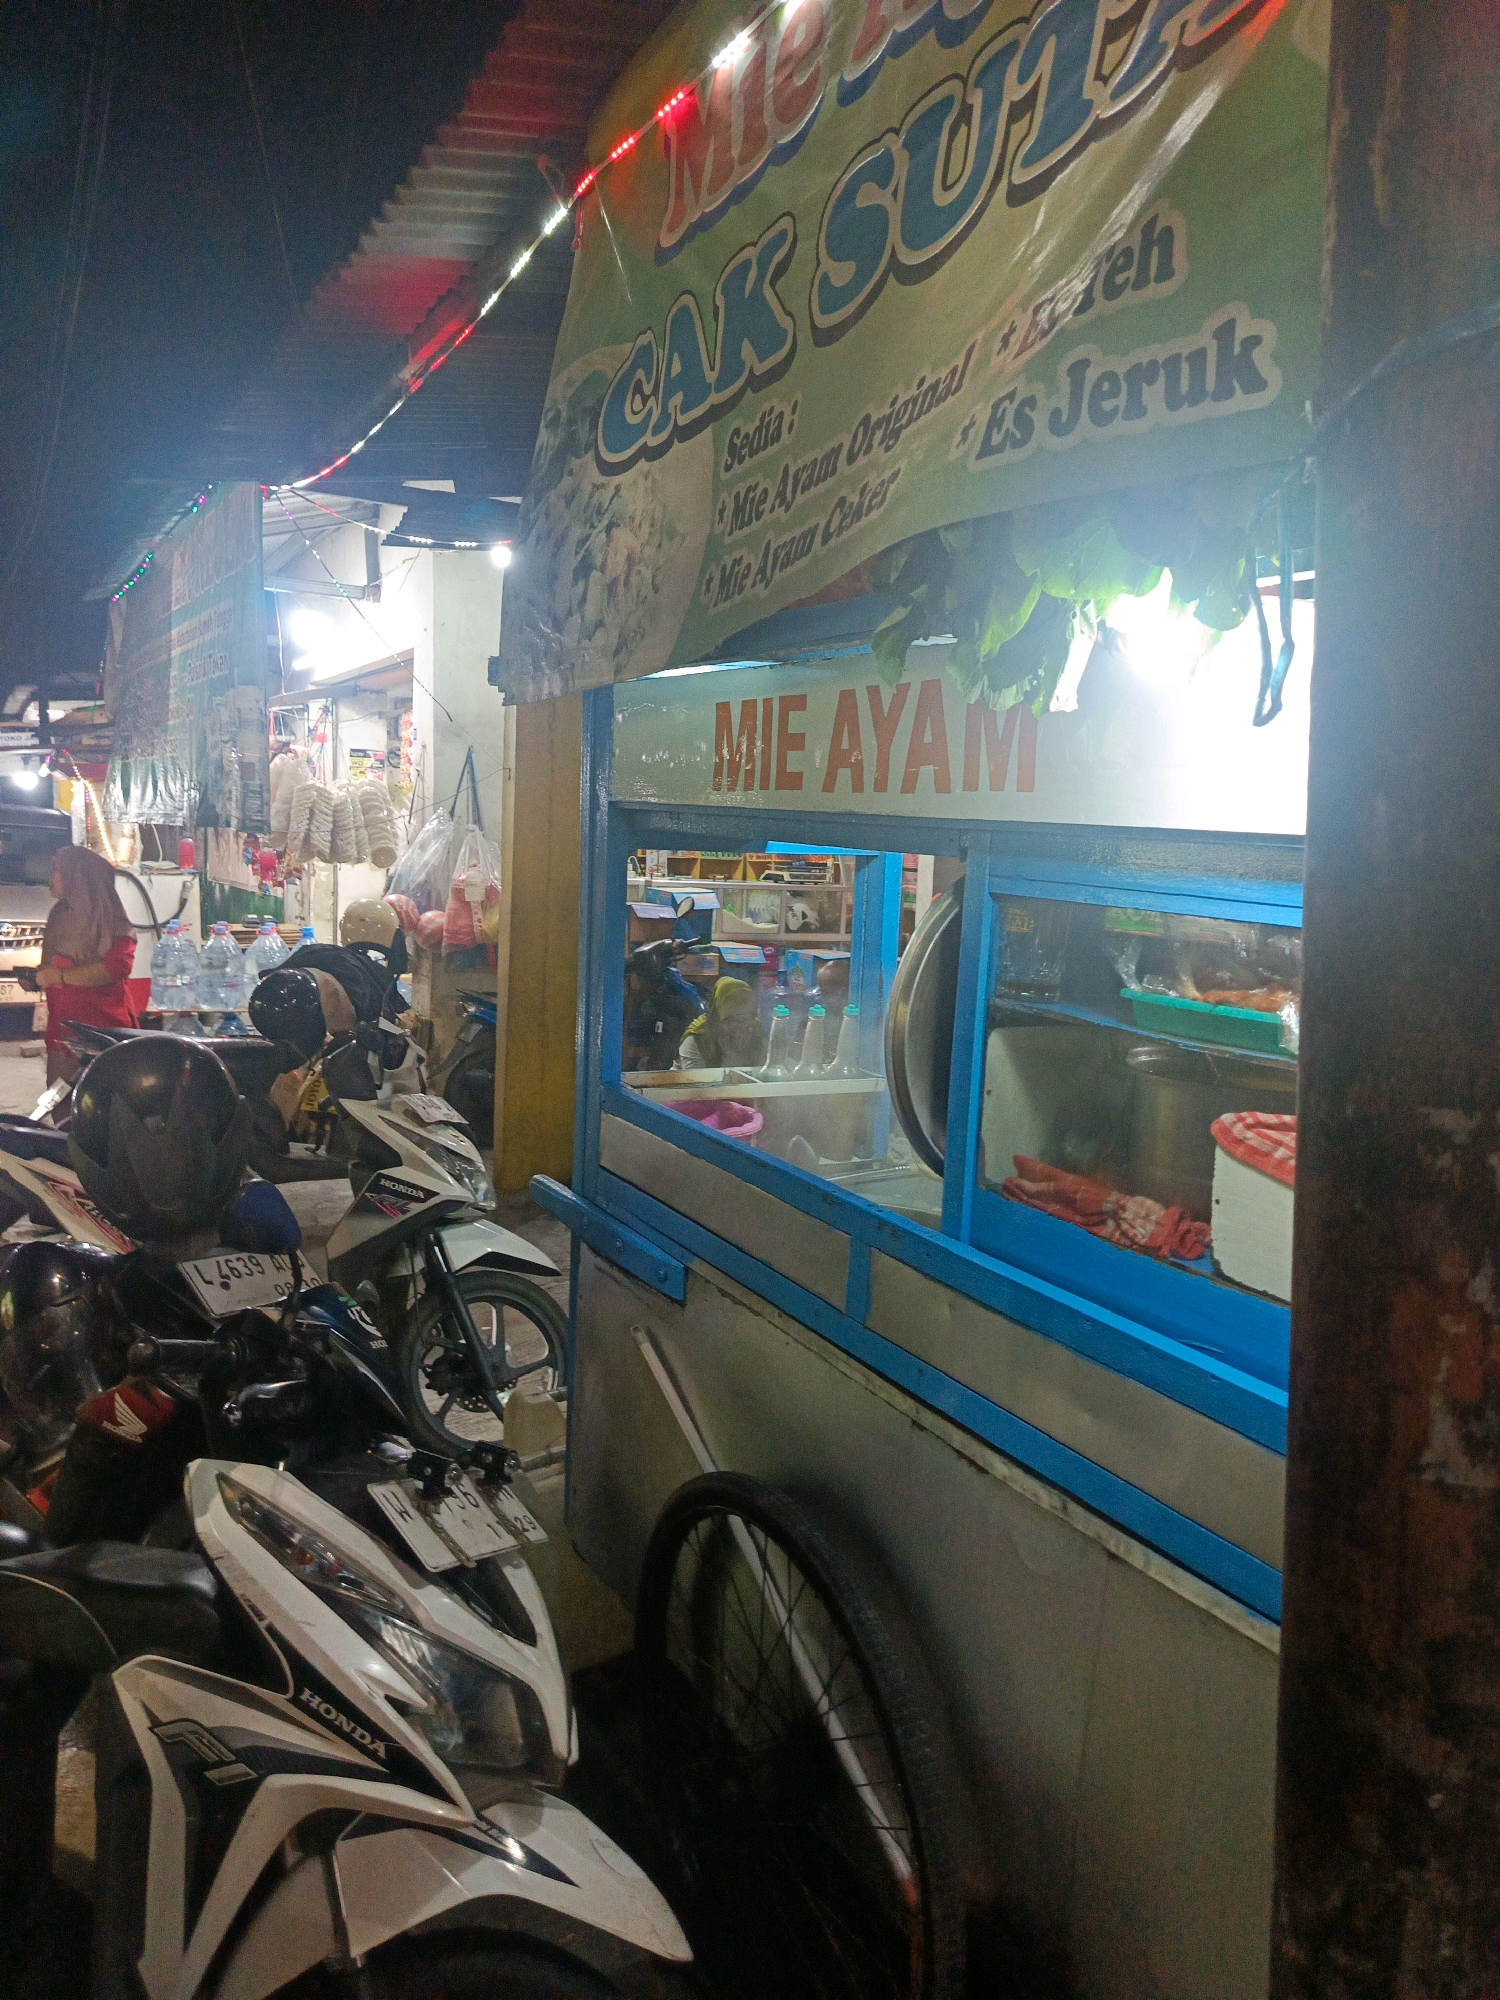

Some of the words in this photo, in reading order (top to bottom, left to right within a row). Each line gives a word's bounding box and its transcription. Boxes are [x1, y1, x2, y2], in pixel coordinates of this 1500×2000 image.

[596, 211, 797, 466] CAK
[975, 387, 1037, 461] Es
[1049, 317, 1268, 438] Jeruk
[728, 482, 768, 537] Mie
[769, 442, 844, 514] Ayam
[846, 337, 979, 467] Original
[713, 555, 751, 608] Mie
[751, 523, 819, 590] Ayam
[821, 467, 901, 547] Ceker
[712, 693, 807, 792] MIE
[822, 679, 1038, 794] AYAM
[380, 1178, 424, 1199] HONDA
[193, 1264, 214, 1286] L
[216, 1255, 265, 1281] 4639
[382, 1491, 413, 1523] W
[513, 1514, 537, 1533] 29
[299, 1687, 387, 1759] HONDA
